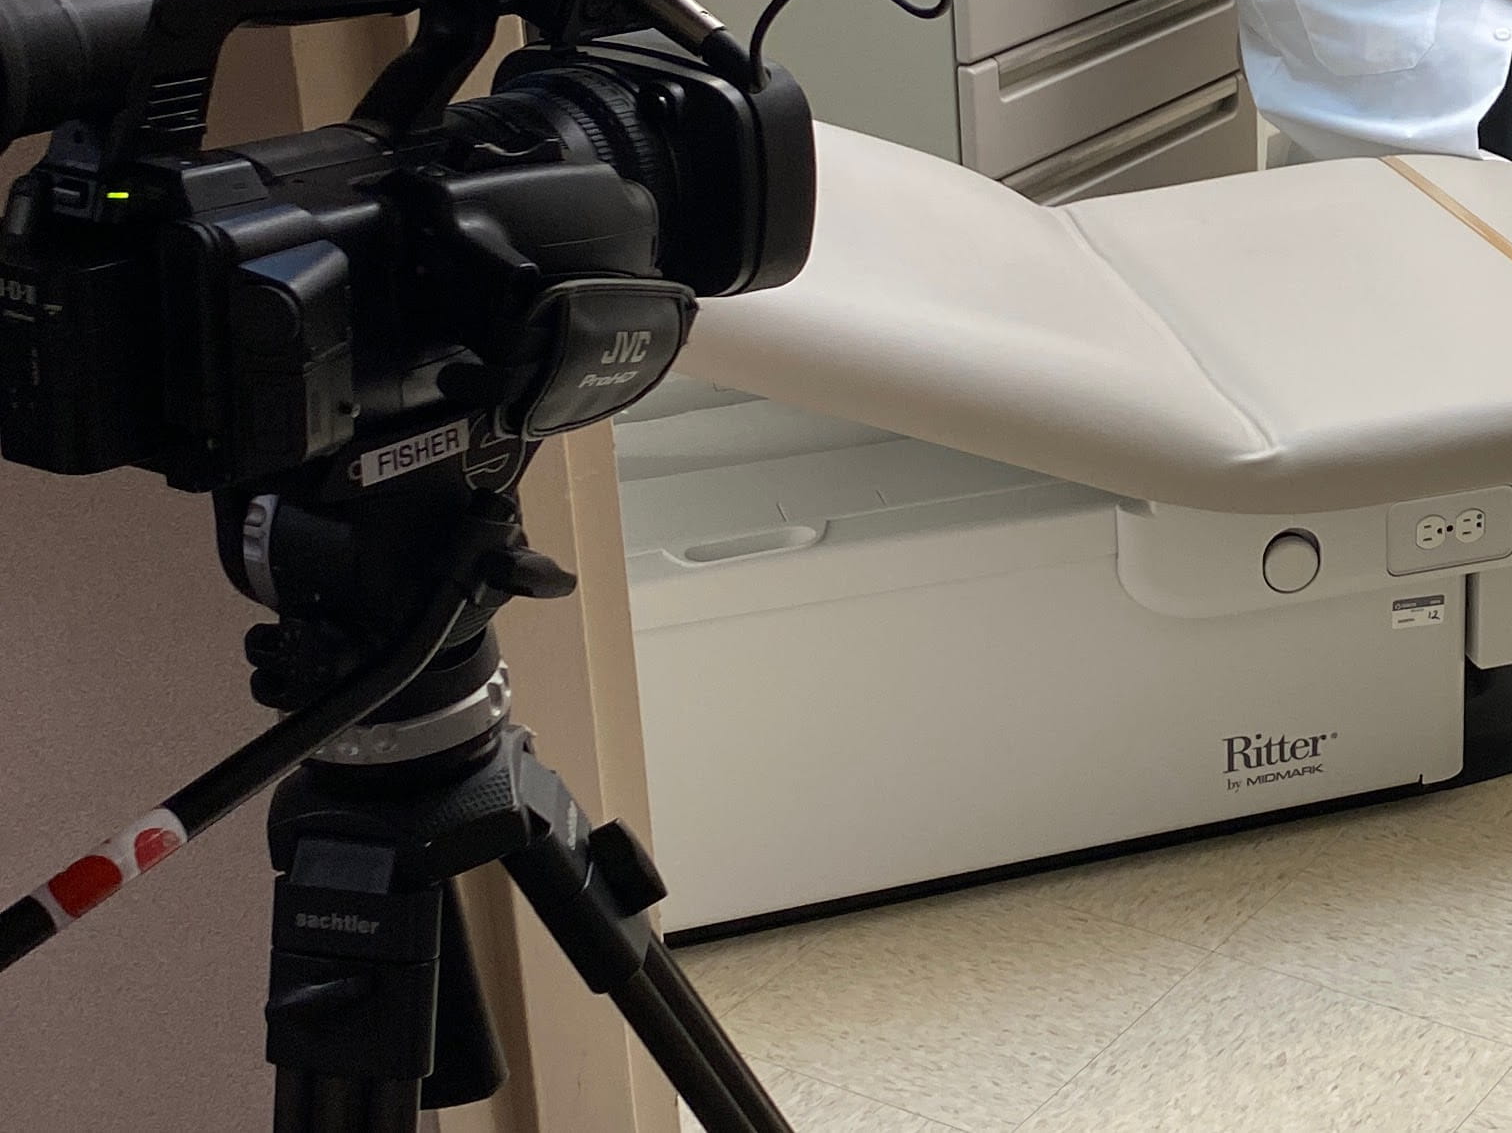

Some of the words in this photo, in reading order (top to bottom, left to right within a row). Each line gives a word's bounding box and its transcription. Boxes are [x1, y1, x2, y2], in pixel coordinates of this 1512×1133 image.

[601, 331, 651, 364] JVC
[578, 371, 639, 389] ProHD
[377, 428, 460, 475] FISHER
[1427, 609, 1441, 621] 12
[1226, 777, 1242, 793] by
[1246, 763, 1324, 787] MIDMARK
[295, 912, 380, 934] sachtler
